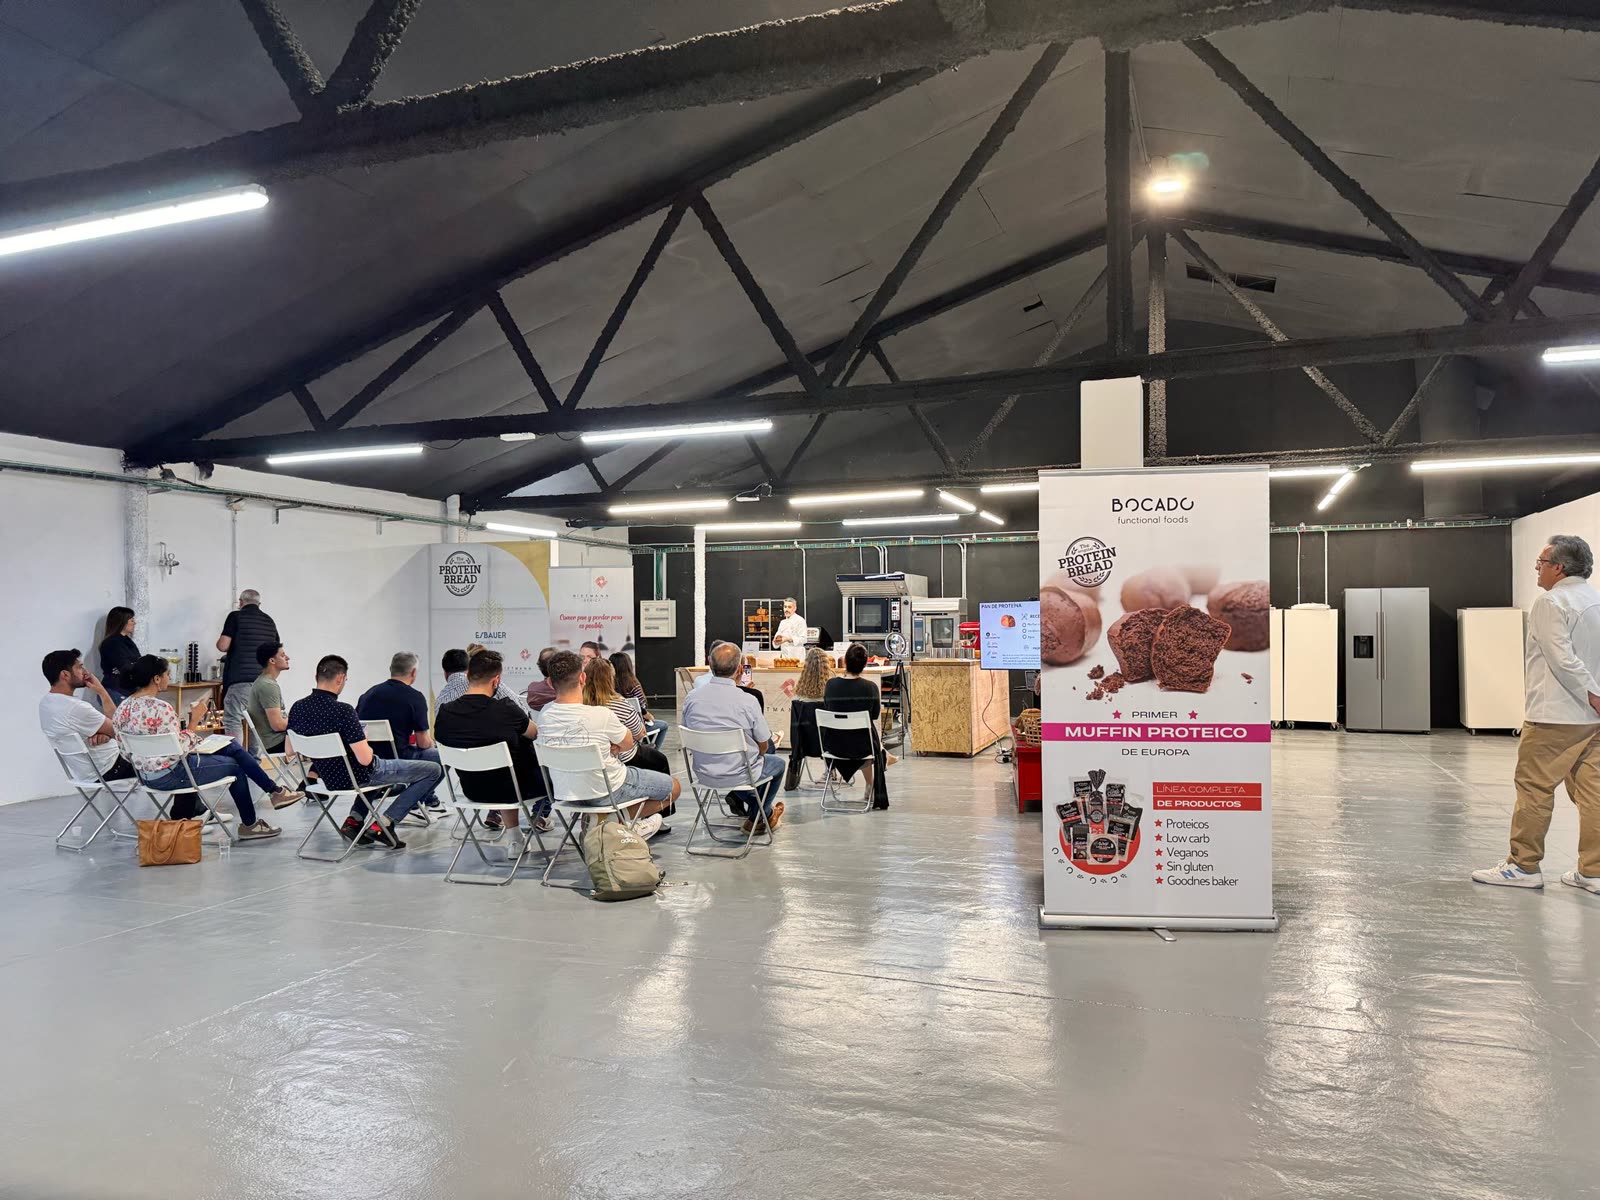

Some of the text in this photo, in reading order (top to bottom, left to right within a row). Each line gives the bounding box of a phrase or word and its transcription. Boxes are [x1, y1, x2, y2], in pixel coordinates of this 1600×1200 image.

[1111, 497, 1194, 512] BOCADO
[1117, 515, 1189, 524] functional foods
[1058, 546, 1117, 569] PROTEIN
[439, 564, 482, 575] PROTEIN
[1067, 559, 1113, 578] BREAD
[443, 574, 478, 584] BREAD
[1131, 711, 1178, 719] PRIMER
[1065, 726, 1248, 739] MUFFIN PROTEICO
[1121, 748, 1190, 757] DE EUROPA
[1156, 784, 1246, 794] LÍNEA COMPLETA
[1174, 800, 1242, 808] PRODUCTOS
[1166, 818, 1210, 829] Proteicos
[1166, 832, 1210, 844] Low carb
[1166, 846, 1209, 861] Veganos
[1166, 860, 1214, 875] Sin gluten
[1167, 875, 1239, 887] Goodnes baker
